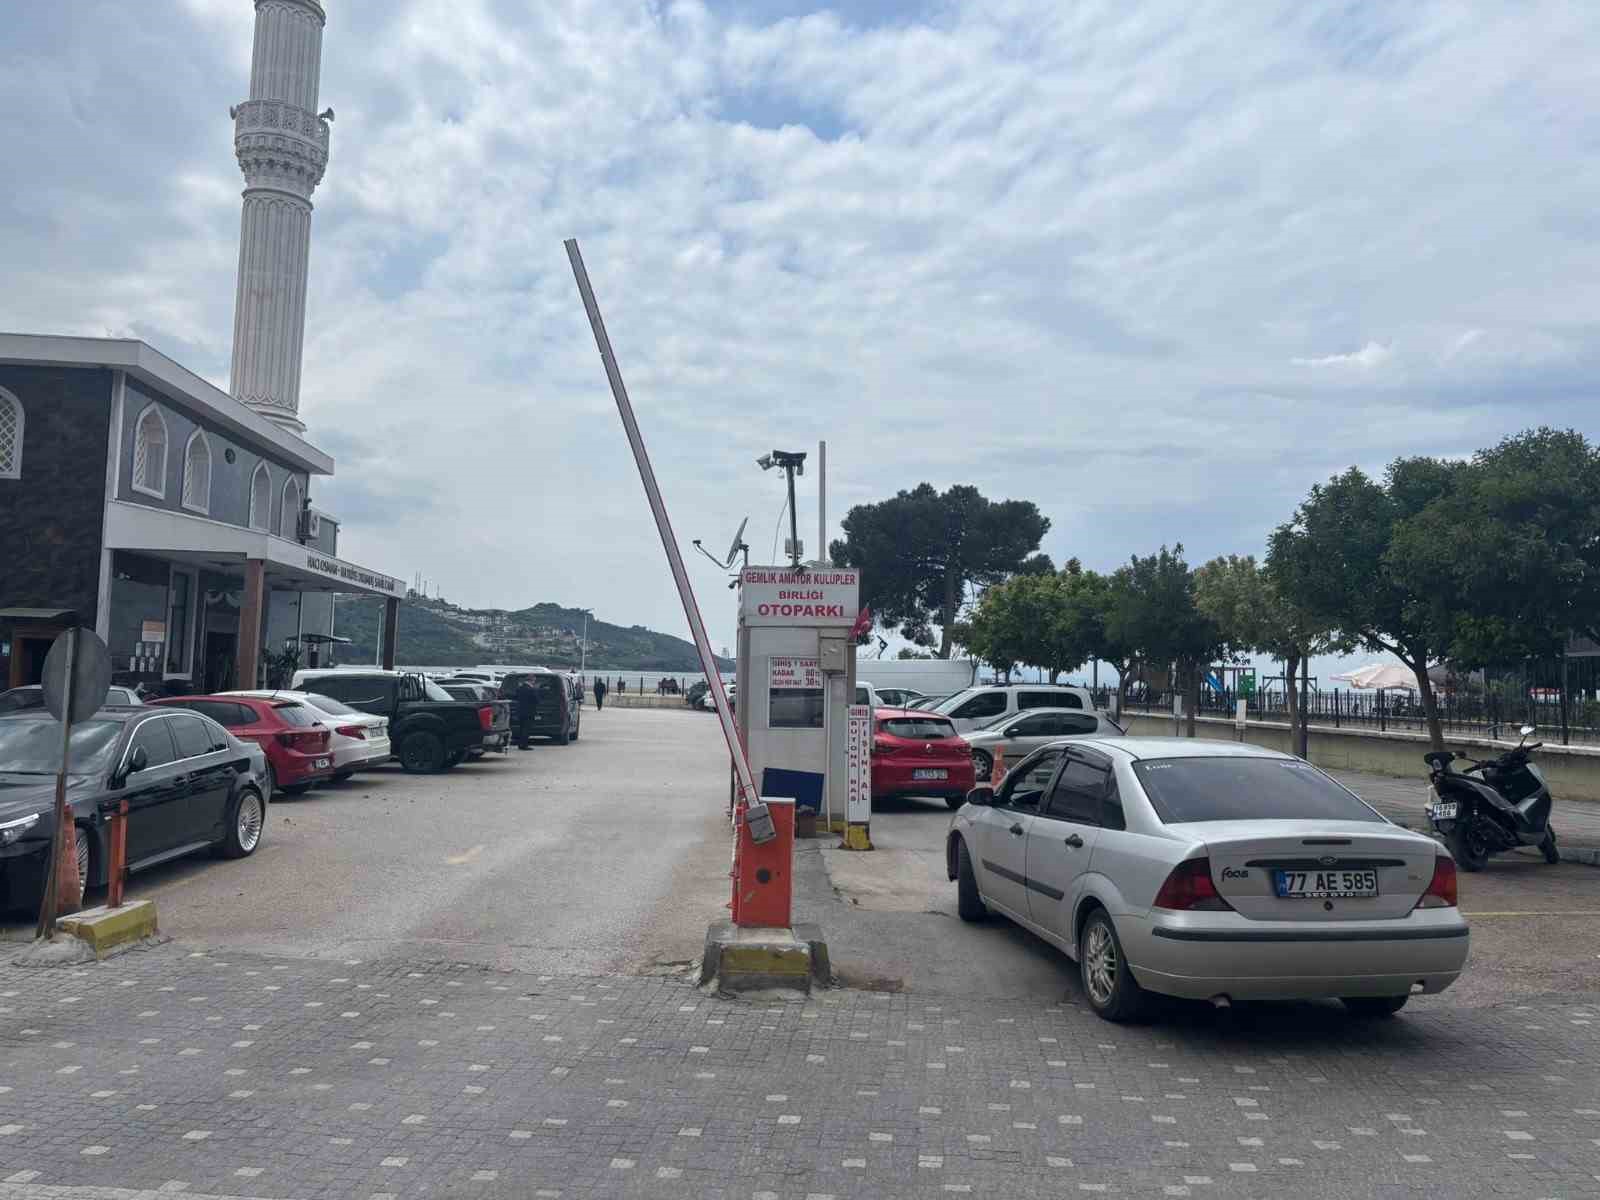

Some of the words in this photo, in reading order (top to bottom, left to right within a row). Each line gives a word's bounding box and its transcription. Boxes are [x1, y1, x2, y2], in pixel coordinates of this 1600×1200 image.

[757, 604, 844, 616] OTOPARKI
[861, 783, 868, 801] AL
[1286, 872, 1307, 891] 77
[1316, 873, 1337, 890] AE
[1343, 872, 1375, 890] 585
